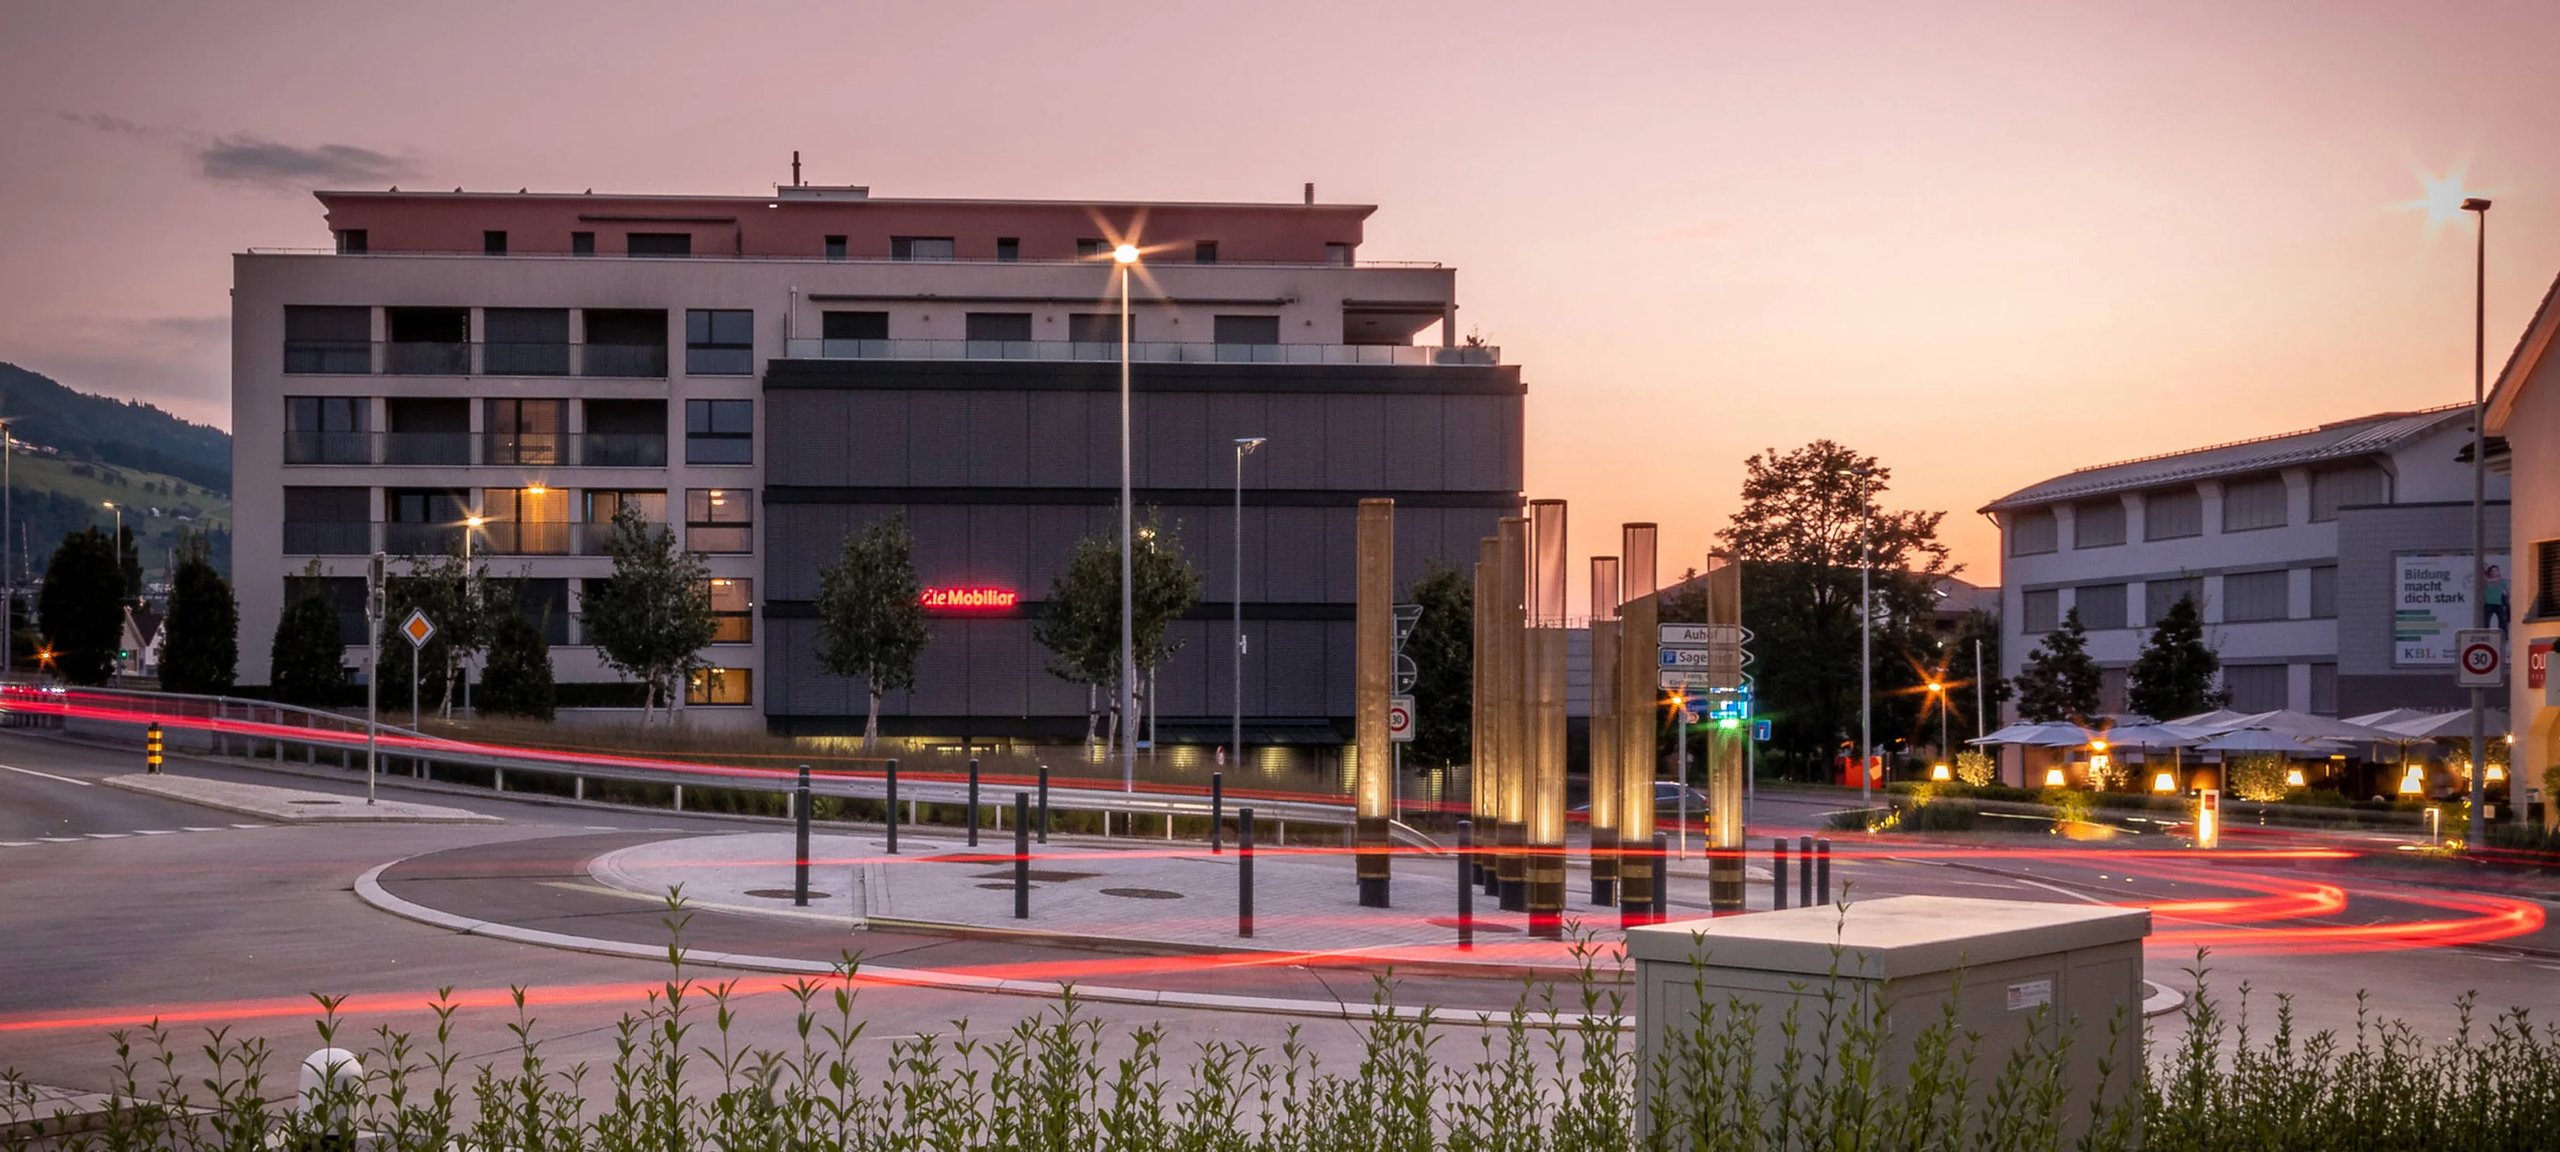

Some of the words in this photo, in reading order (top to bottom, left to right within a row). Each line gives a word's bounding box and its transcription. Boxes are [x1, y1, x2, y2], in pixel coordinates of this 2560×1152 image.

[2404, 569, 2450, 581] Bildung
[2404, 581, 2442, 592] macht
[947, 589, 1015, 605] Mobiliar
[2404, 593, 2431, 603] dich
[2434, 592, 2465, 603] stark
[2404, 649, 2434, 659] KBL
[2473, 653, 2488, 665] 30
[1392, 714, 1402, 724] 30
